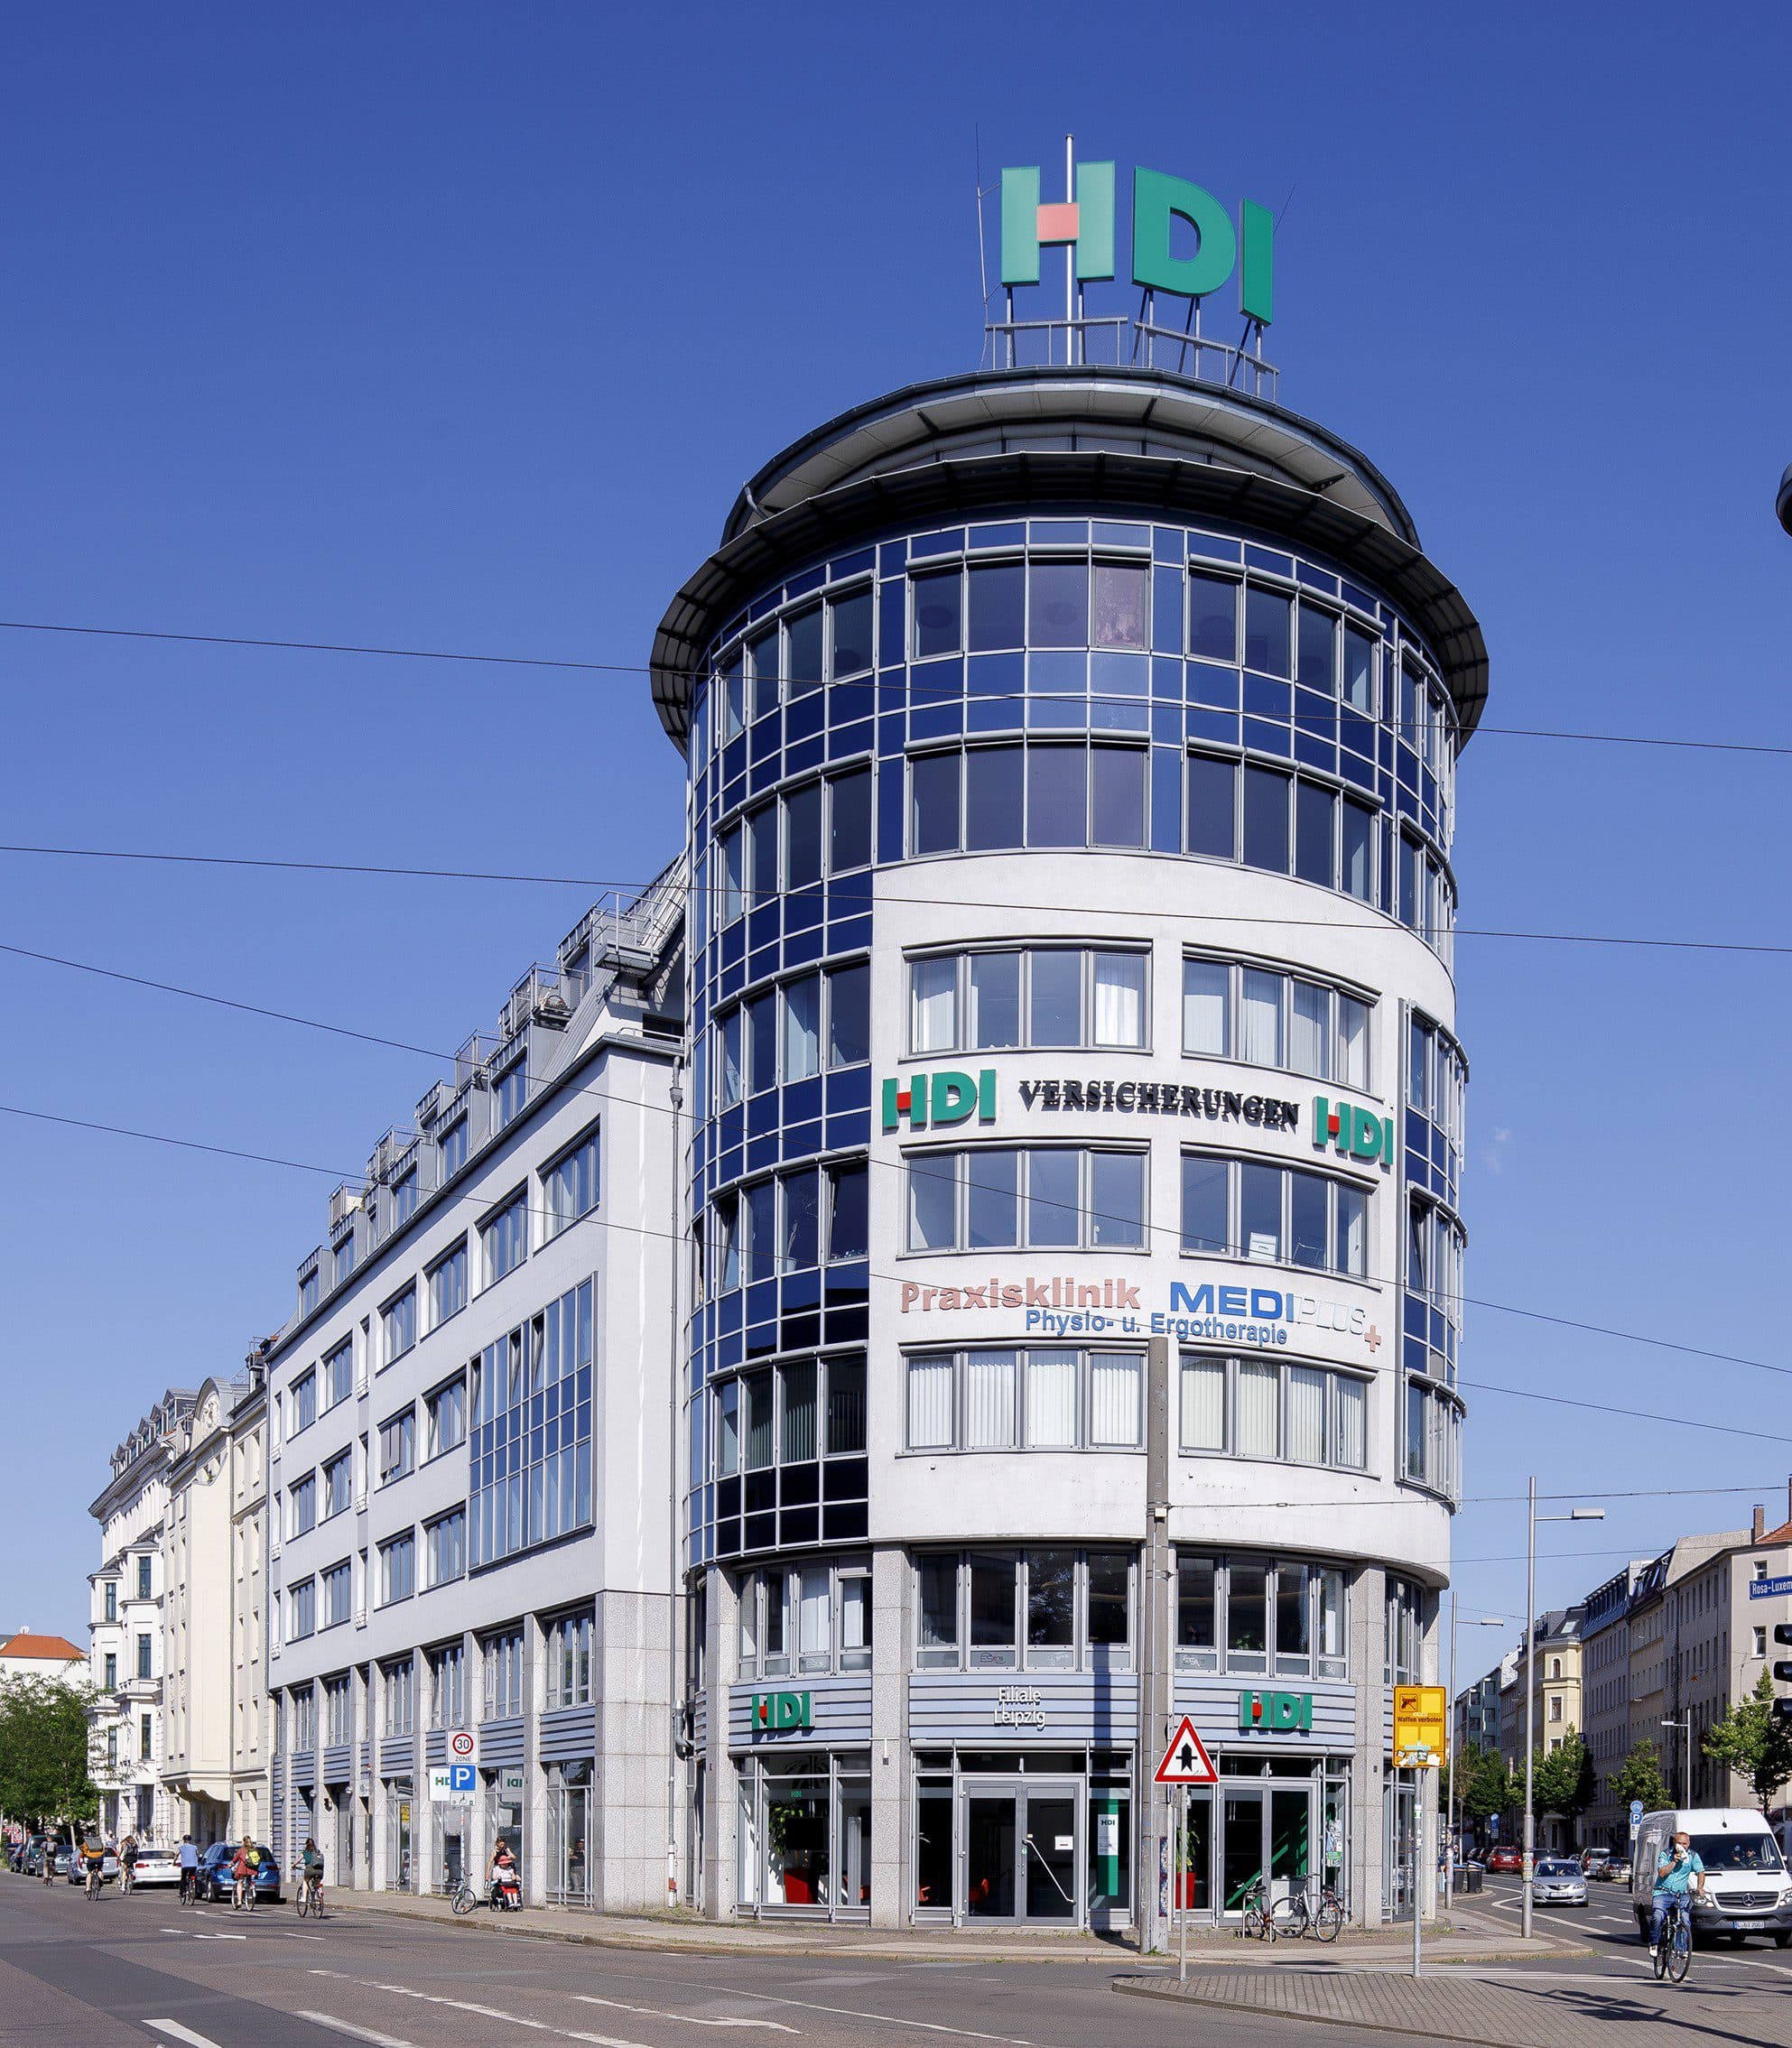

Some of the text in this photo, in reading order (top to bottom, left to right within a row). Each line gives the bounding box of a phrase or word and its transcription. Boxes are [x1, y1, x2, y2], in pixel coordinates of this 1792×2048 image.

[1001, 161, 1274, 326] HDI
[882, 1069, 1394, 1166] HDI VERSICHERUNGEN HDI
[901, 1276, 1141, 1313] Praxisklinik
[1026, 1310, 1287, 1347] Physio- u. Ergotherapie
[751, 1691, 816, 1730] HDI
[998, 1686, 1042, 1702] Filiale
[1239, 1691, 1313, 1730] HDI
[994, 1701, 1046, 1728] Leipzig
[456, 1738, 470, 1749] 30
[456, 1768, 470, 1788] P
[1632, 1813, 1640, 1823] P
